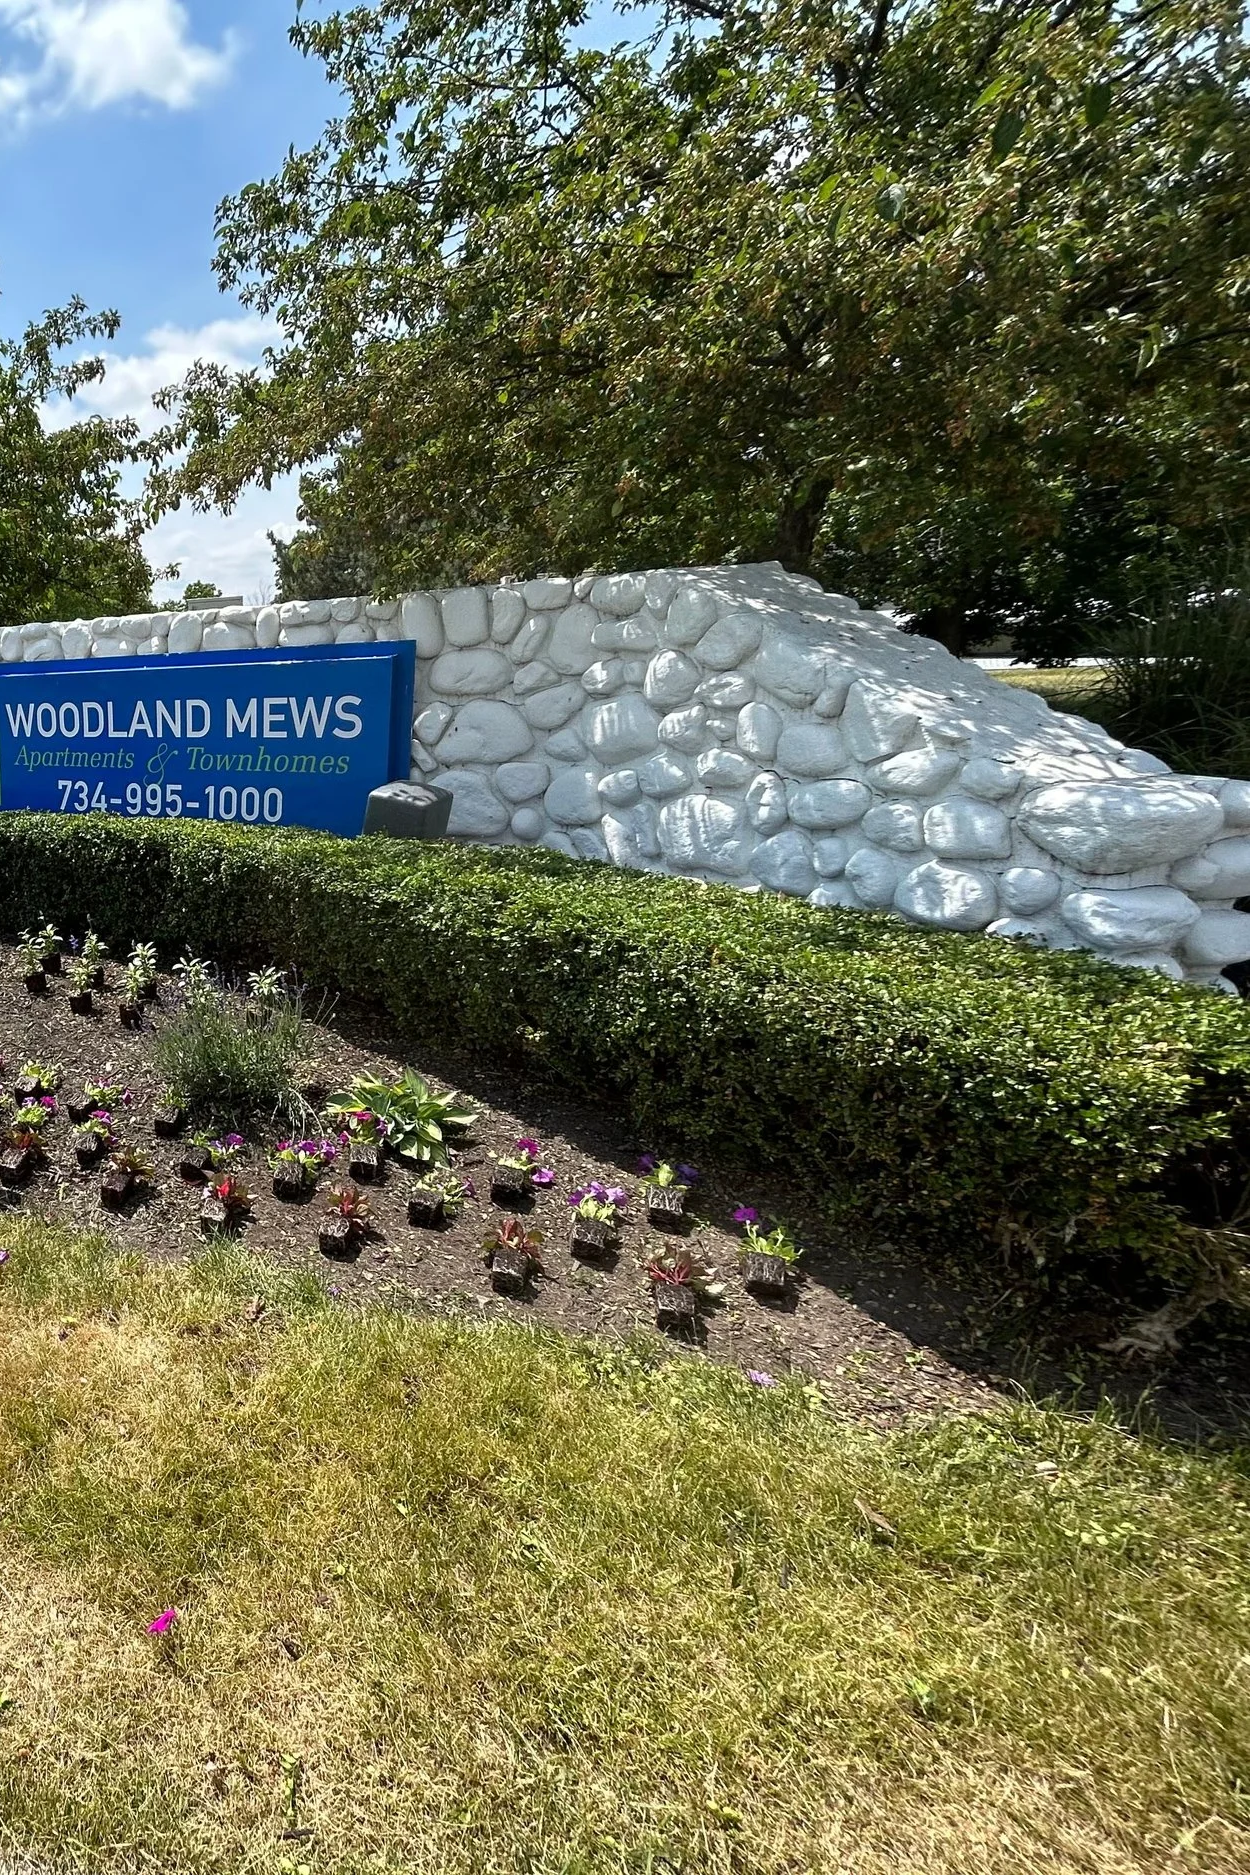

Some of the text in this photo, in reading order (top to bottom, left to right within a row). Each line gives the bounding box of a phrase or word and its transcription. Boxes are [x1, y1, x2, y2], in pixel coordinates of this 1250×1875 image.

[5, 695, 363, 739] WOODLAND MEWS
[14, 742, 350, 788] Apartments & Townhomes
[57, 778, 284, 823] 734-995-1000
